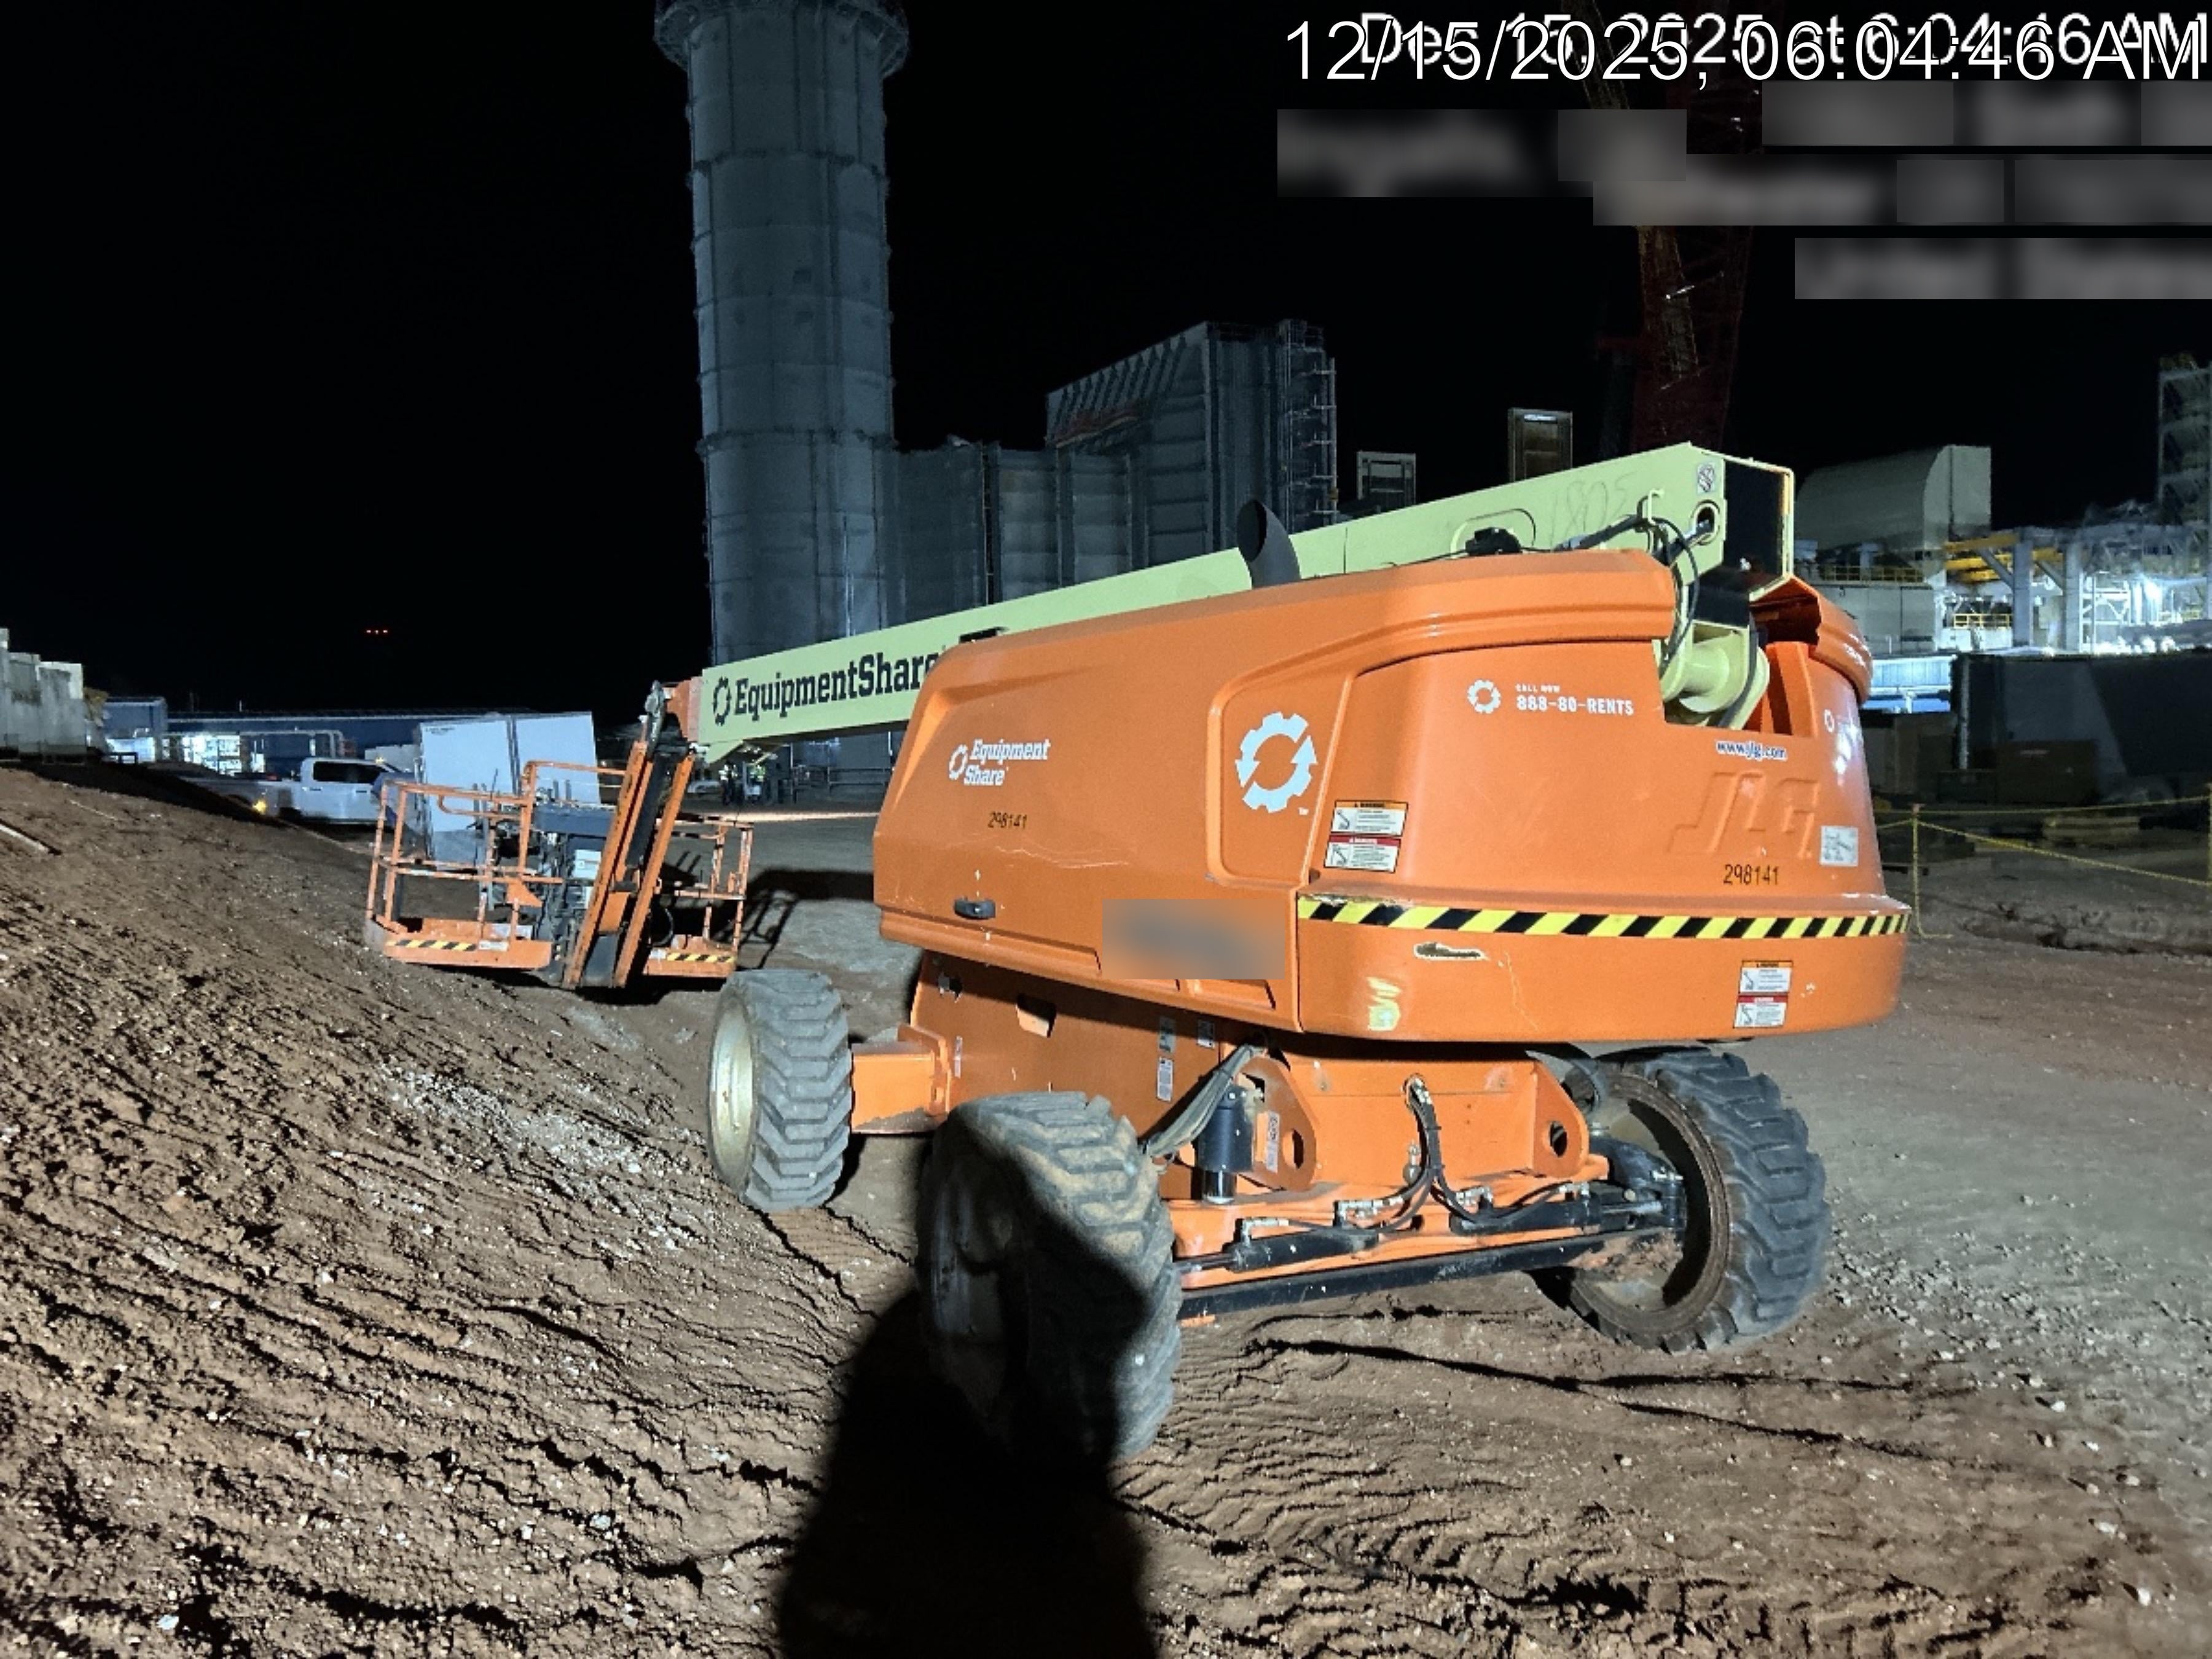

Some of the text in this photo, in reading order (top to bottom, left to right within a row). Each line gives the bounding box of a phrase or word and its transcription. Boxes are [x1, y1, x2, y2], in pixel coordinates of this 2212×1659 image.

[1516, 695, 1634, 715] 888-80-RENTS
[970, 739, 1051, 766] Equipment
[963, 764, 1005, 786] Share
[988, 811, 1027, 829] 298141
[1723, 864, 1779, 885] 298141
